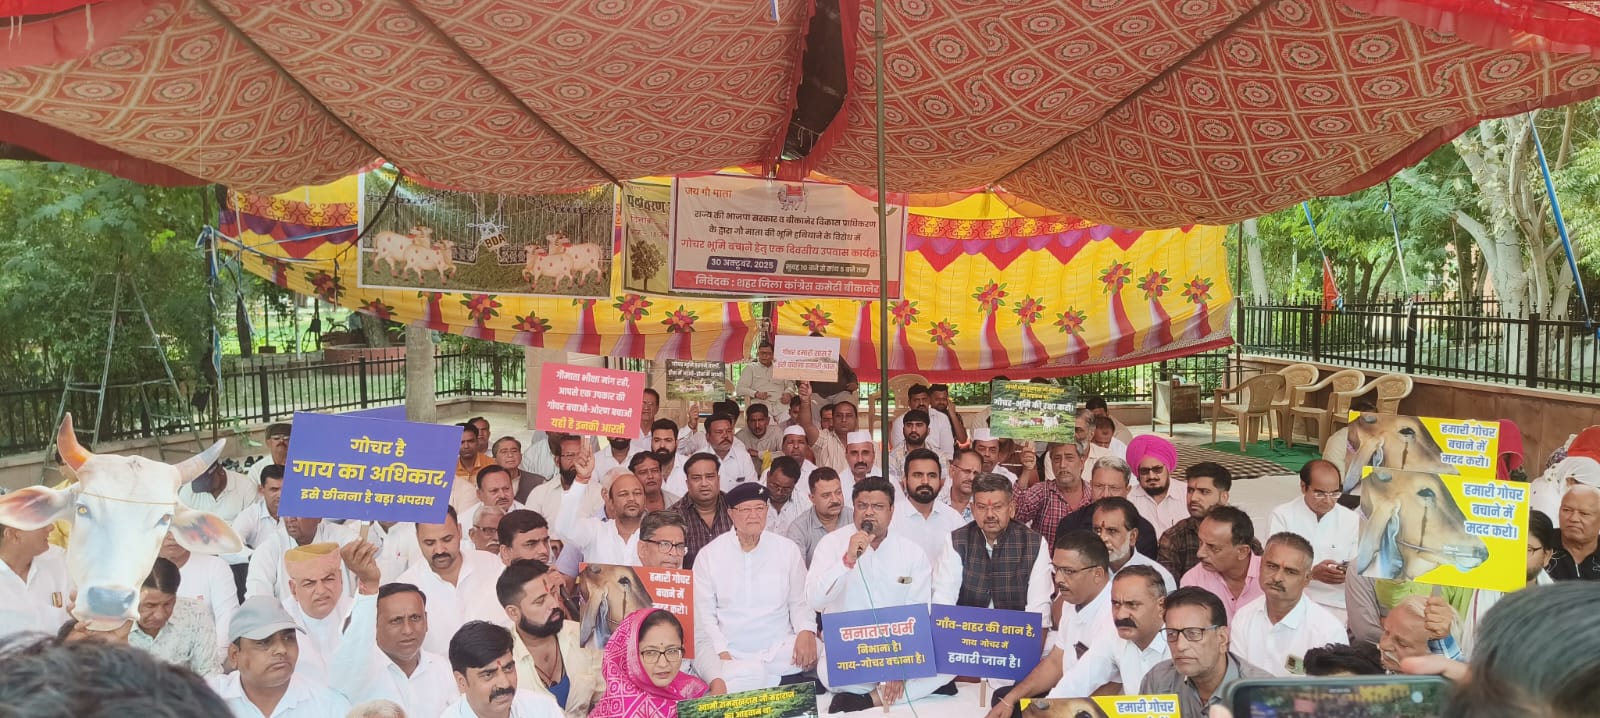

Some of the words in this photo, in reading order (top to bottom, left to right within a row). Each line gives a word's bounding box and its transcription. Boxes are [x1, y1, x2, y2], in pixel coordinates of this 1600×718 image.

[685, 187, 699, 195] जय
[700, 187, 711, 196] गौ
[713, 189, 732, 198] माता
[695, 210, 712, 218] राज्य
[714, 209, 724, 220] की
[726, 212, 750, 221] भाजपा
[752, 214, 777, 222] सरकार
[786, 213, 814, 224] बीकानेर
[816, 215, 840, 226] विकास
[843, 218, 876, 228] प्राधिकरण
[709, 224, 716, 233] के
[718, 227, 732, 236] द्वारा
[734, 225, 743, 235] गौ
[745, 228, 762, 236] माता
[765, 227, 775, 237] की
[777, 229, 792, 240] भूमि
[795, 229, 822, 240] हथियाने
[824, 232, 831, 240] के
[833, 231, 853, 241] विरोध
[484, 234, 506, 247] BDA
[682, 239, 704, 248] गोचर
[706, 239, 726, 252] भूमि
[729, 240, 752, 251] बचाने
[755, 244, 767, 254] हेतु
[769, 244, 784, 253] एक
[786, 244, 819, 254] दिवसीय
[821, 247, 849, 256] उपवास
[851, 247, 880, 256] कार्यक्र
[711, 258, 721, 266] 30
[755, 261, 774, 269] 2025
[696, 275, 729, 285] निवेदक
[731, 279, 735, 287] :
[737, 278, 756, 289] शहर
[758, 278, 782, 289] जिला
[785, 281, 813, 291] कांग्रेस
[815, 281, 842, 291] कमेटी
[844, 282, 880, 293] बीकानेर
[559, 386, 578, 396] आपसे
[580, 389, 592, 397] एक
[593, 391, 614, 400] उपकार
[616, 392, 626, 401] की
[1032, 400, 1041, 408] की
[551, 417, 567, 428] यही
[568, 417, 574, 428] है
[576, 420, 599, 431] इनकी
[602, 423, 625, 434] आरती
[1442, 423, 1469, 434] हमारी
[1471, 425, 1496, 436] गोचर
[351, 436, 393, 455] गोचर
[395, 438, 406, 457] है
[1448, 439, 1474, 449] बचाने
[1476, 440, 1487, 451] में
[1442, 454, 1464, 464] मदद
[1466, 455, 1489, 466] करो।
[293, 461, 335, 477] गाय
[338, 464, 366, 480] का
[370, 463, 448, 487] अधिकार,
[301, 487, 320, 499] इसे
[323, 488, 361, 501] छीनना
[365, 490, 373, 503] है
[375, 494, 394, 506] बड़ा
[396, 496, 435, 506] अपराध
[1464, 482, 1495, 496] हमारी
[1497, 484, 1524, 500] गोचर
[1472, 503, 1500, 516] बचाने
[1503, 505, 1515, 518] में
[1466, 522, 1491, 534] मदद
[1493, 523, 1517, 537] करो।
[649, 572, 670, 582] हमारी
[672, 572, 690, 584] गोचर
[656, 588, 675, 598] बचाने
[676, 588, 685, 599] में
[841, 626, 890, 640] सनातन
[891, 617, 916, 636] धर्म
[936, 618, 983, 632] गाँव-शहर
[986, 620, 1000, 633] की
[1002, 625, 1024, 635] शान
[1026, 624, 1035, 637] है,
[858, 643, 890, 654] निभाना
[892, 641, 901, 652] है।
[961, 638, 976, 647] गाय
[980, 638, 1000, 648] गोचर
[1000, 640, 1008, 649] में
[837, 658, 885, 670] गाय-गोचर
[887, 655, 914, 666] बचाना
[915, 653, 925, 664] है।
[948, 652, 980, 664] हमारी
[982, 656, 1006, 666] जान
[1009, 655, 1021, 667] है।
[698, 701, 718, 711] स्वामी
[760, 694, 768, 703] जी
[770, 691, 795, 701] महाराज
[1118, 700, 1146, 712] हमारी
[1149, 701, 1174, 712] गोचर
